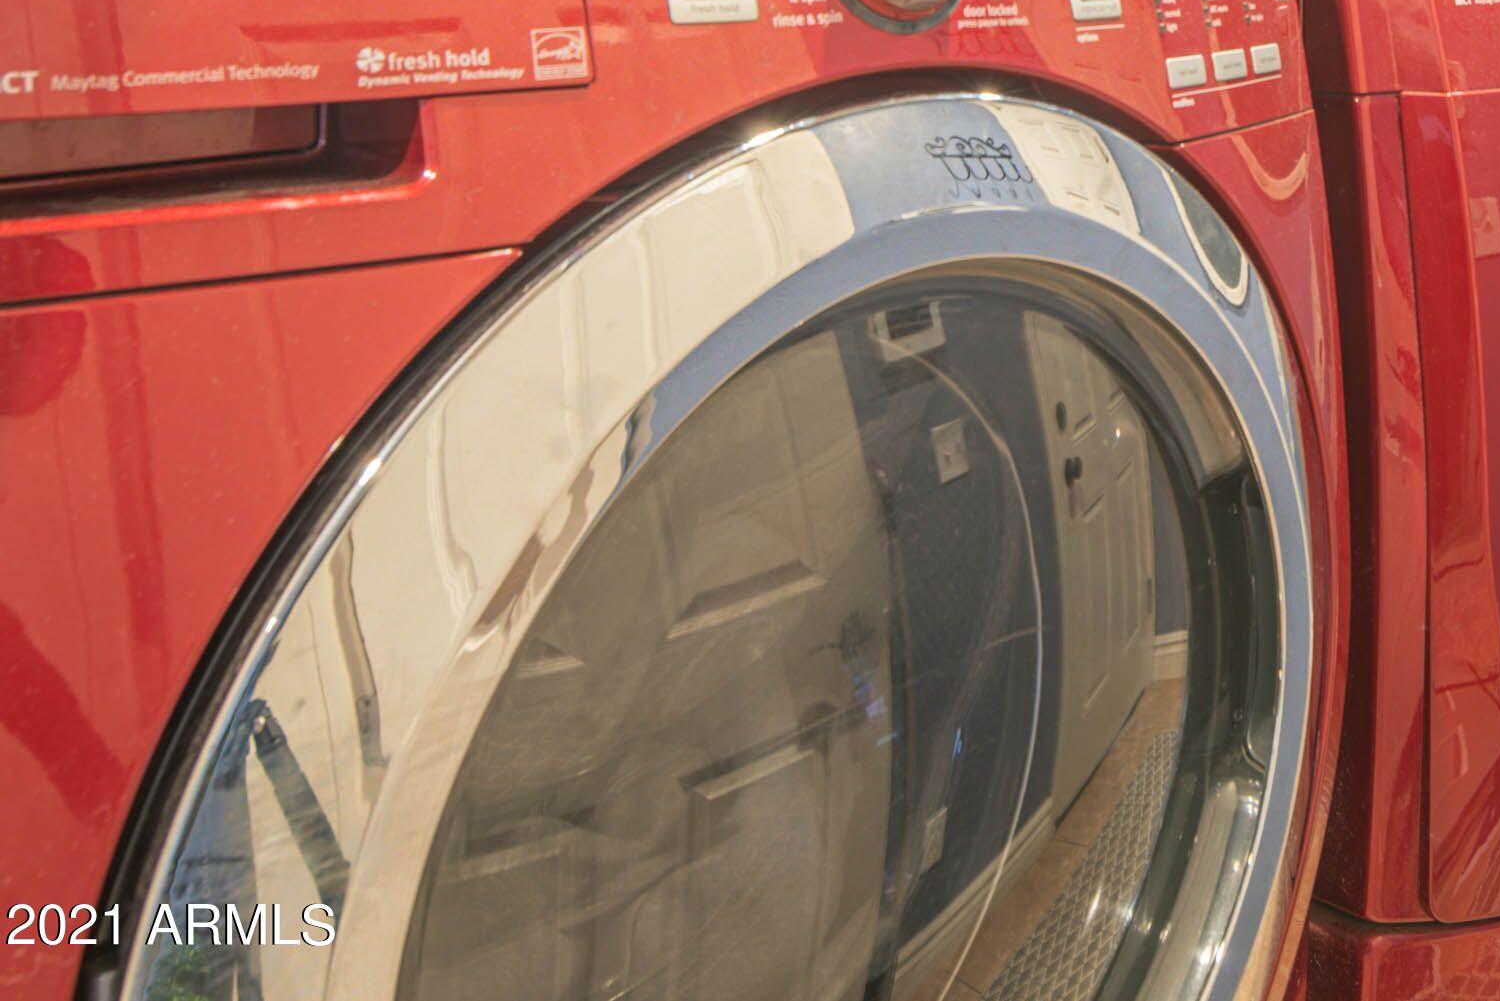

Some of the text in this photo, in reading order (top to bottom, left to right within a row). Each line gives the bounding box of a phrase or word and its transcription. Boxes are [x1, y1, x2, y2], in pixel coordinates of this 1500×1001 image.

[772, 10, 843, 28] rinse & spin
[387, 48, 491, 71] fresh hold
[0, 61, 319, 94] CT Maytag Commercial Technology
[357, 74, 410, 89] Dynamic
[413, 70, 458, 84] Venting
[460, 66, 525, 81] Technology
